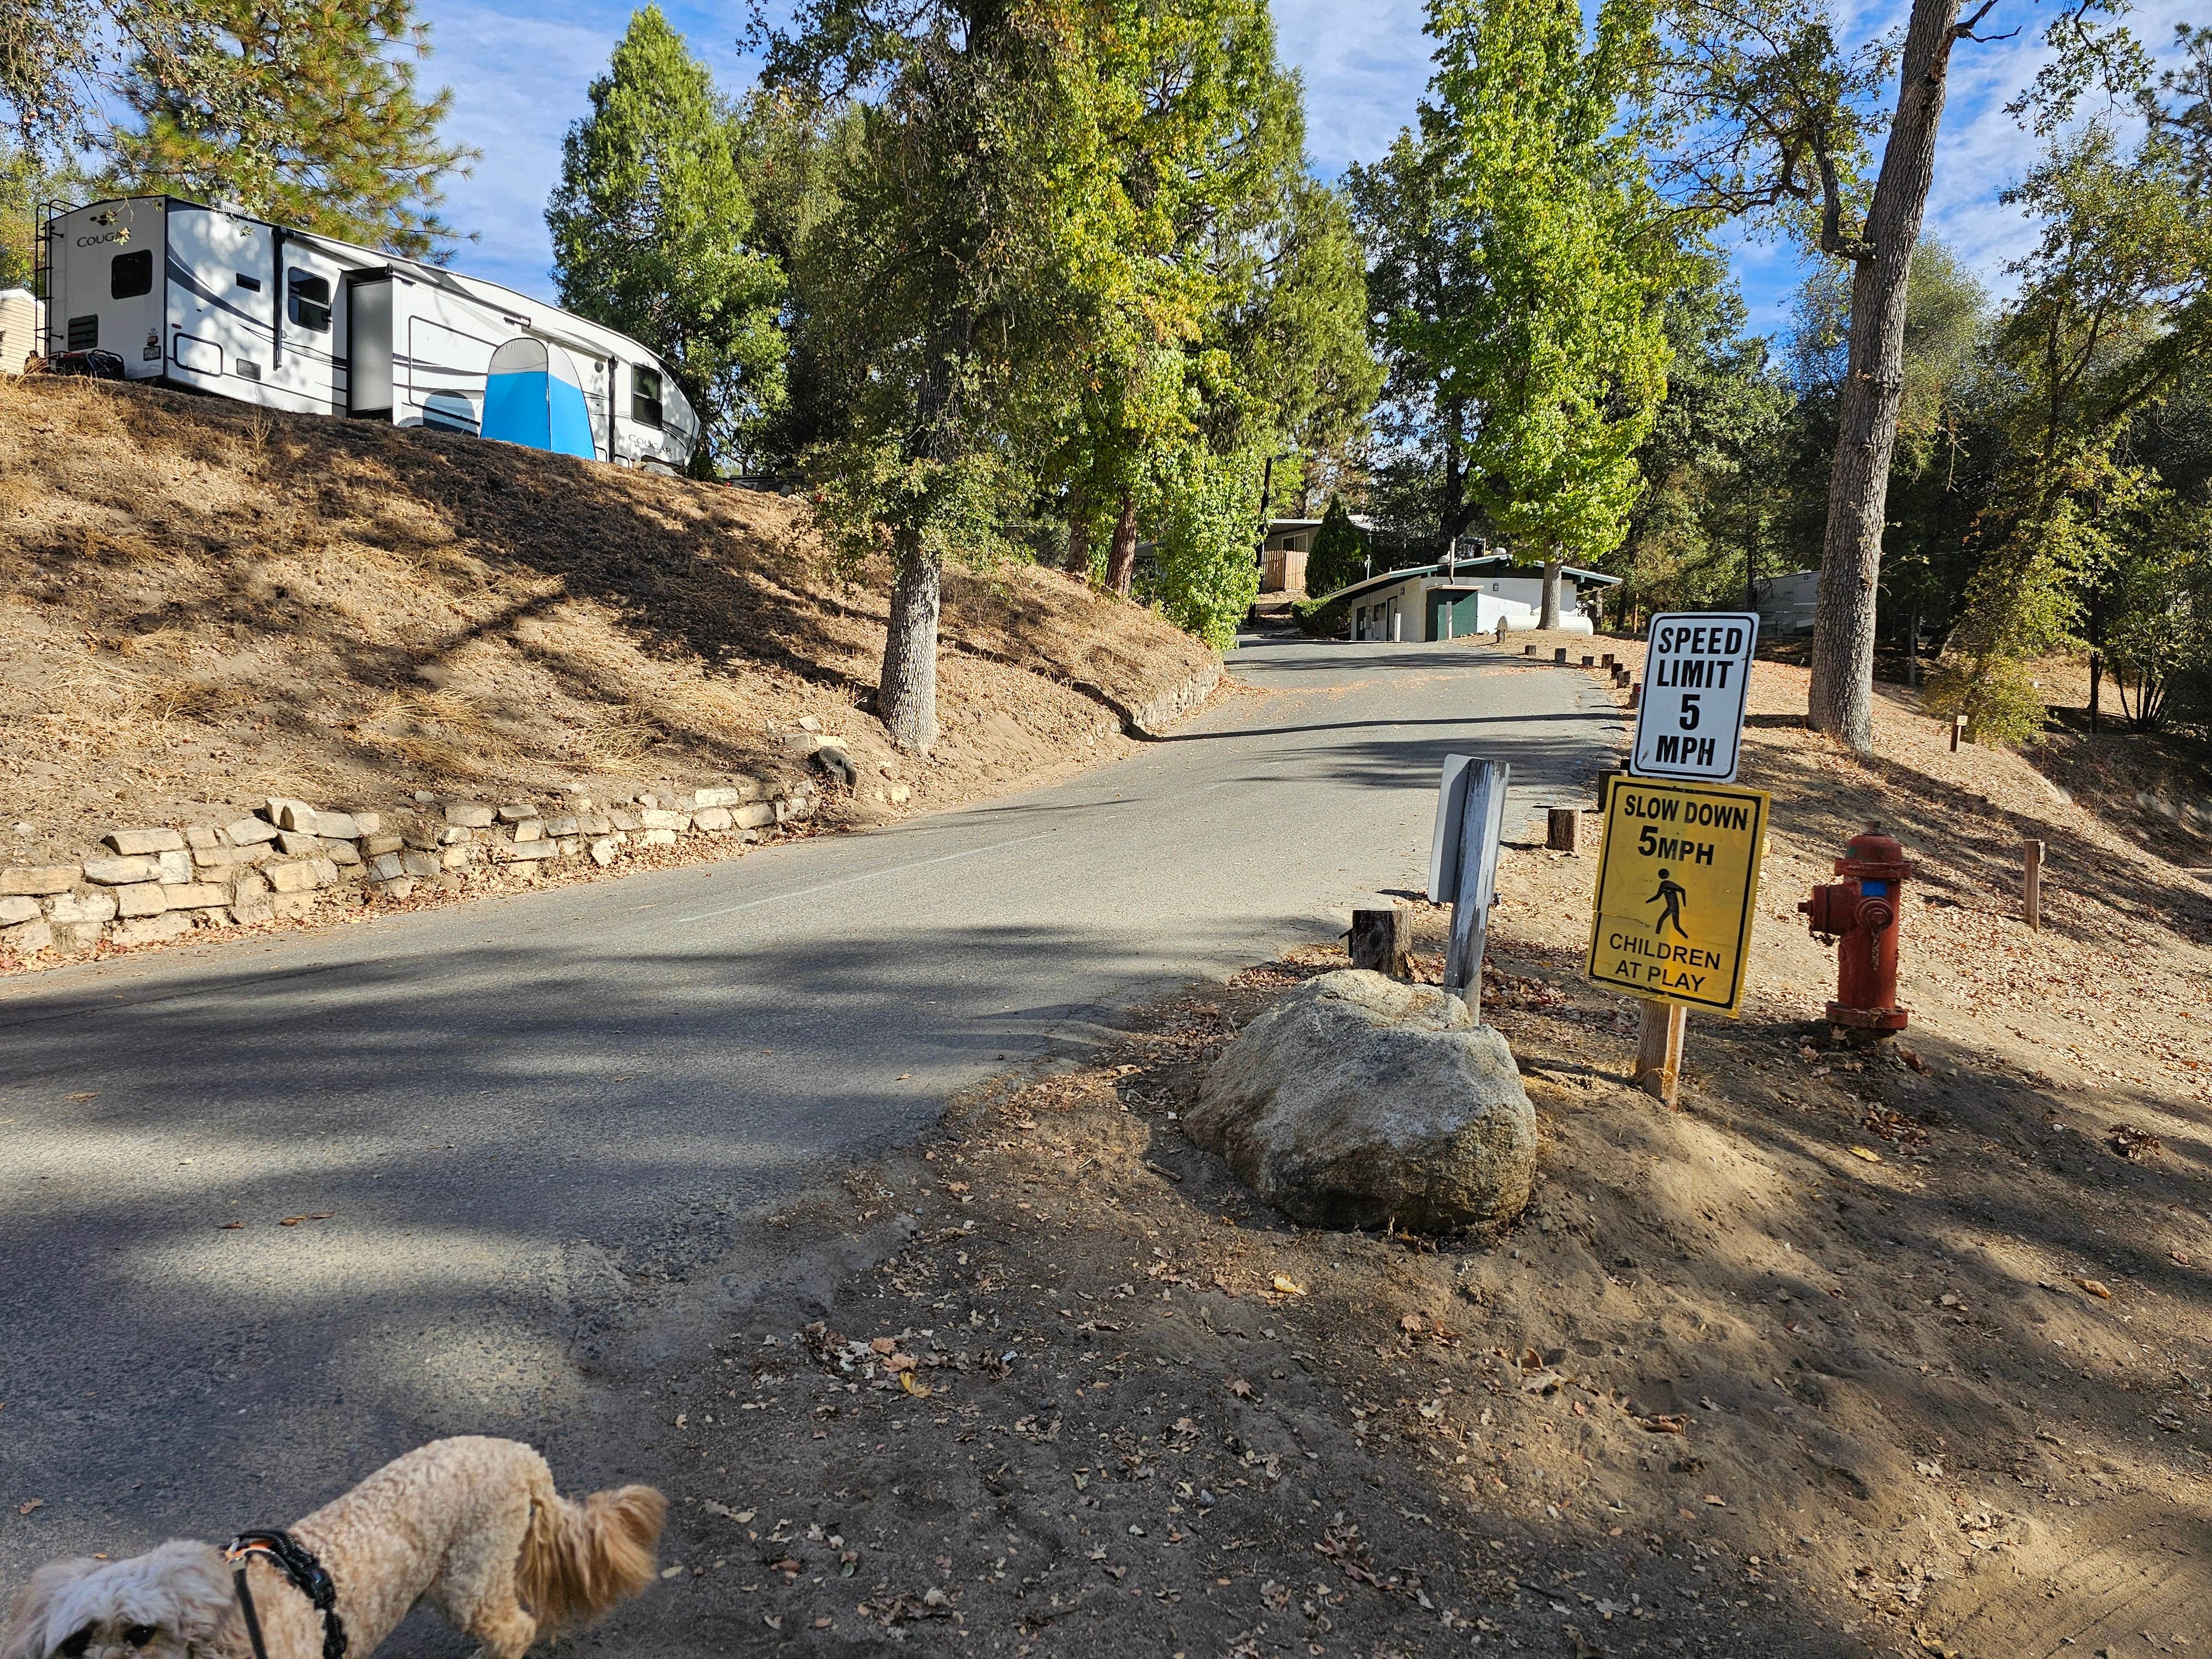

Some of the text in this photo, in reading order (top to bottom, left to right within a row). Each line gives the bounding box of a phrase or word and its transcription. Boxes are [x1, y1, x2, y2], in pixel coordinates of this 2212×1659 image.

[77, 228, 132, 247] COUG
[628, 434, 672, 456] COUGAR
[1658, 627, 1743, 655] SPEED
[1657, 660, 1734, 688] LIMIT
[1679, 694, 1700, 731] 5
[1655, 735, 1715, 766] MPH
[1624, 795, 1749, 831] SLOW DOWN
[1637, 825, 1714, 865] 5MPH
[1610, 933, 1721, 970] CHILDREN
[1615, 959, 1706, 992] AT PLAY
